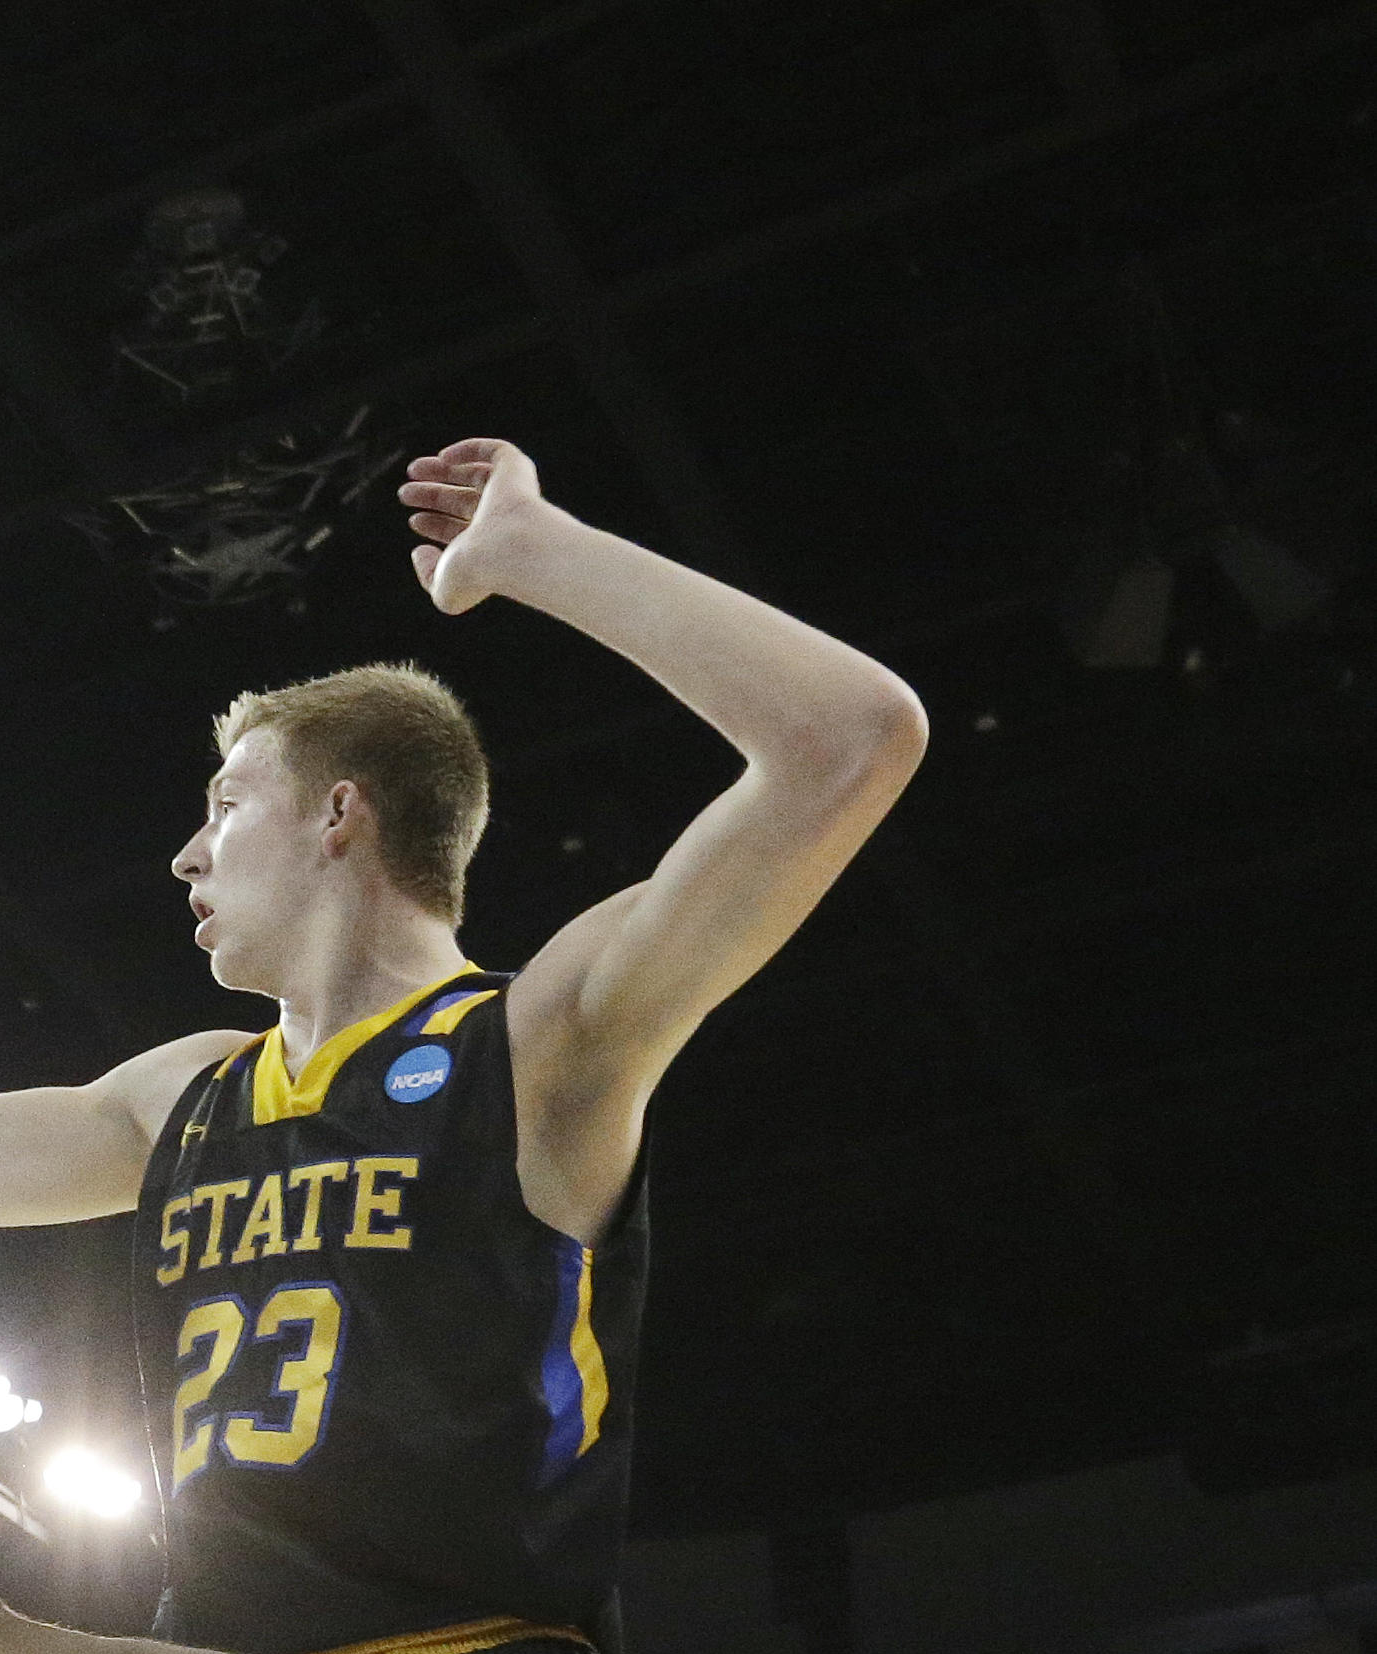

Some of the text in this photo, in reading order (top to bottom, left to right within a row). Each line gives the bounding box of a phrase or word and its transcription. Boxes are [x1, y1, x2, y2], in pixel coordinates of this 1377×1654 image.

[391, 1069, 444, 1090] NCAA
[156, 1155, 420, 1286] STATE
[170, 1281, 344, 1496] 23
